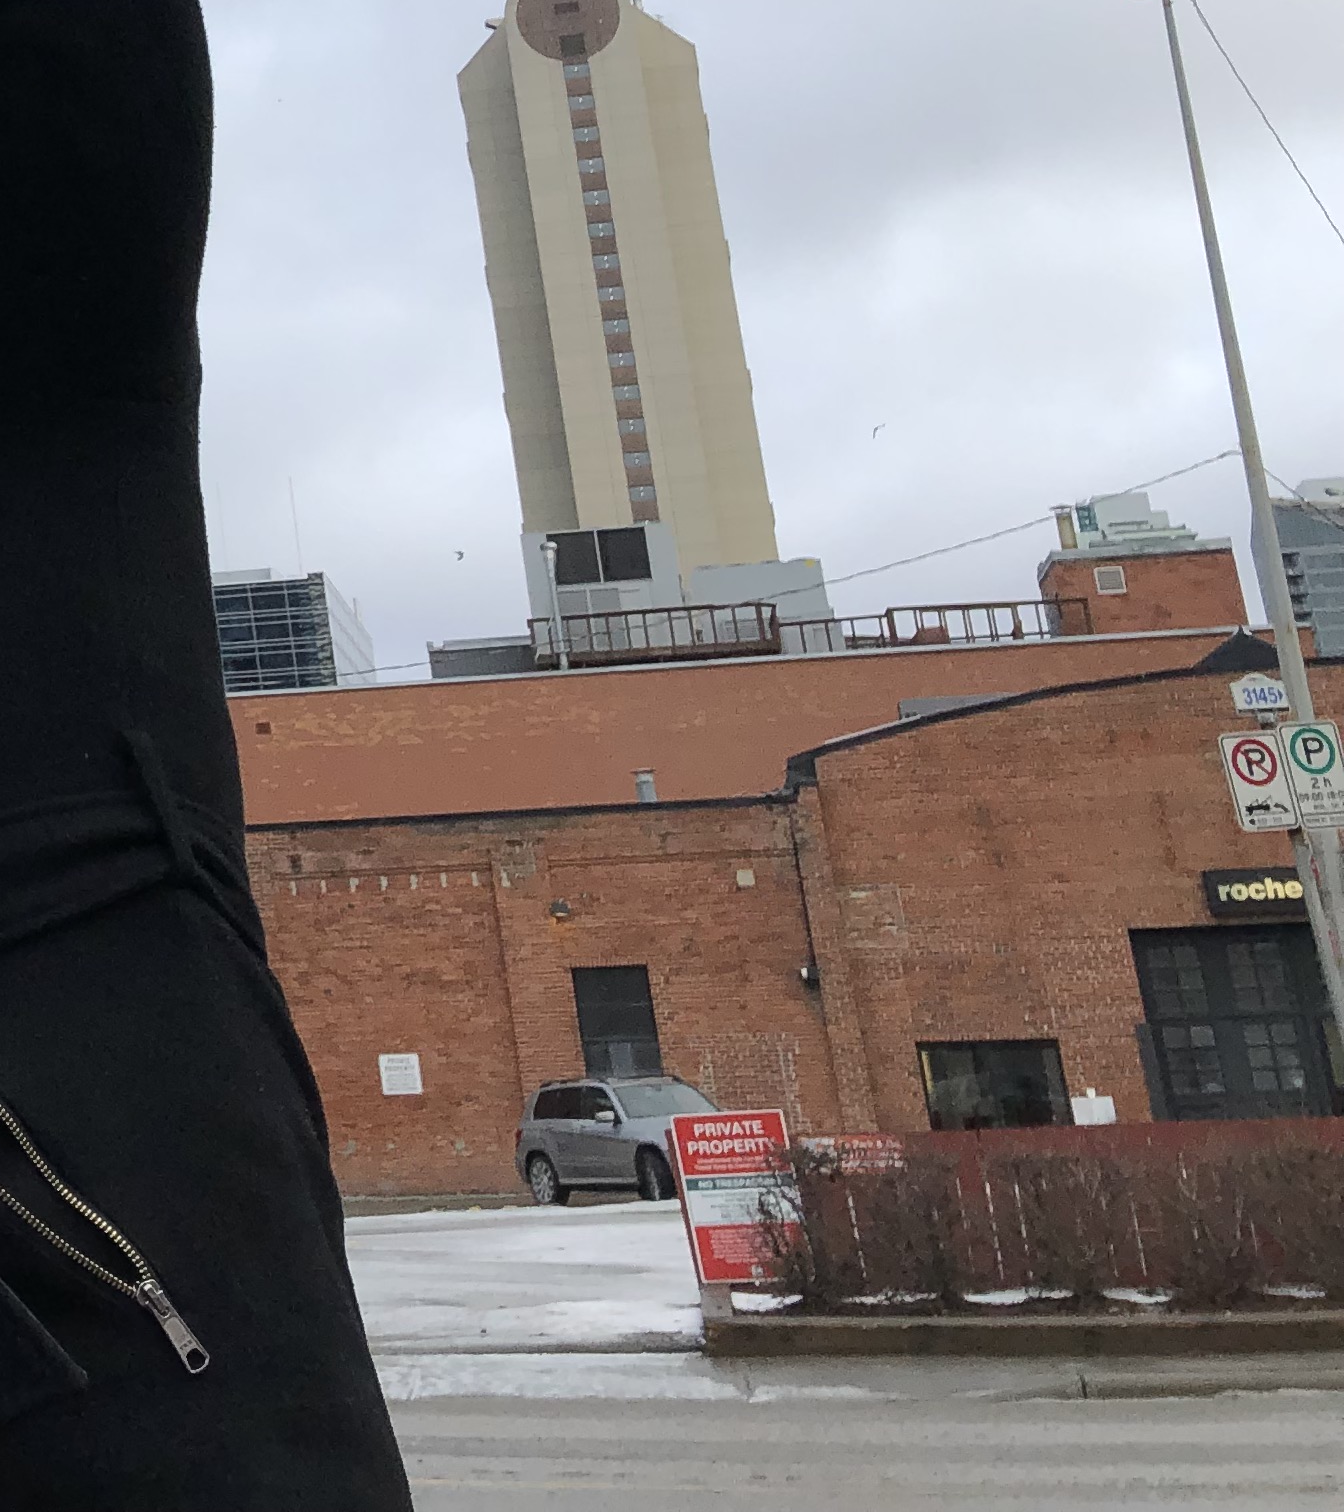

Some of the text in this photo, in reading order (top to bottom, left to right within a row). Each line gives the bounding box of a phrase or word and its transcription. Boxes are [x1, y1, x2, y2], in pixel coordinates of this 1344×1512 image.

[1242, 686, 1278, 706] 3145
[1217, 876, 1304, 902] roche
[693, 1119, 765, 1138] PRIVATE
